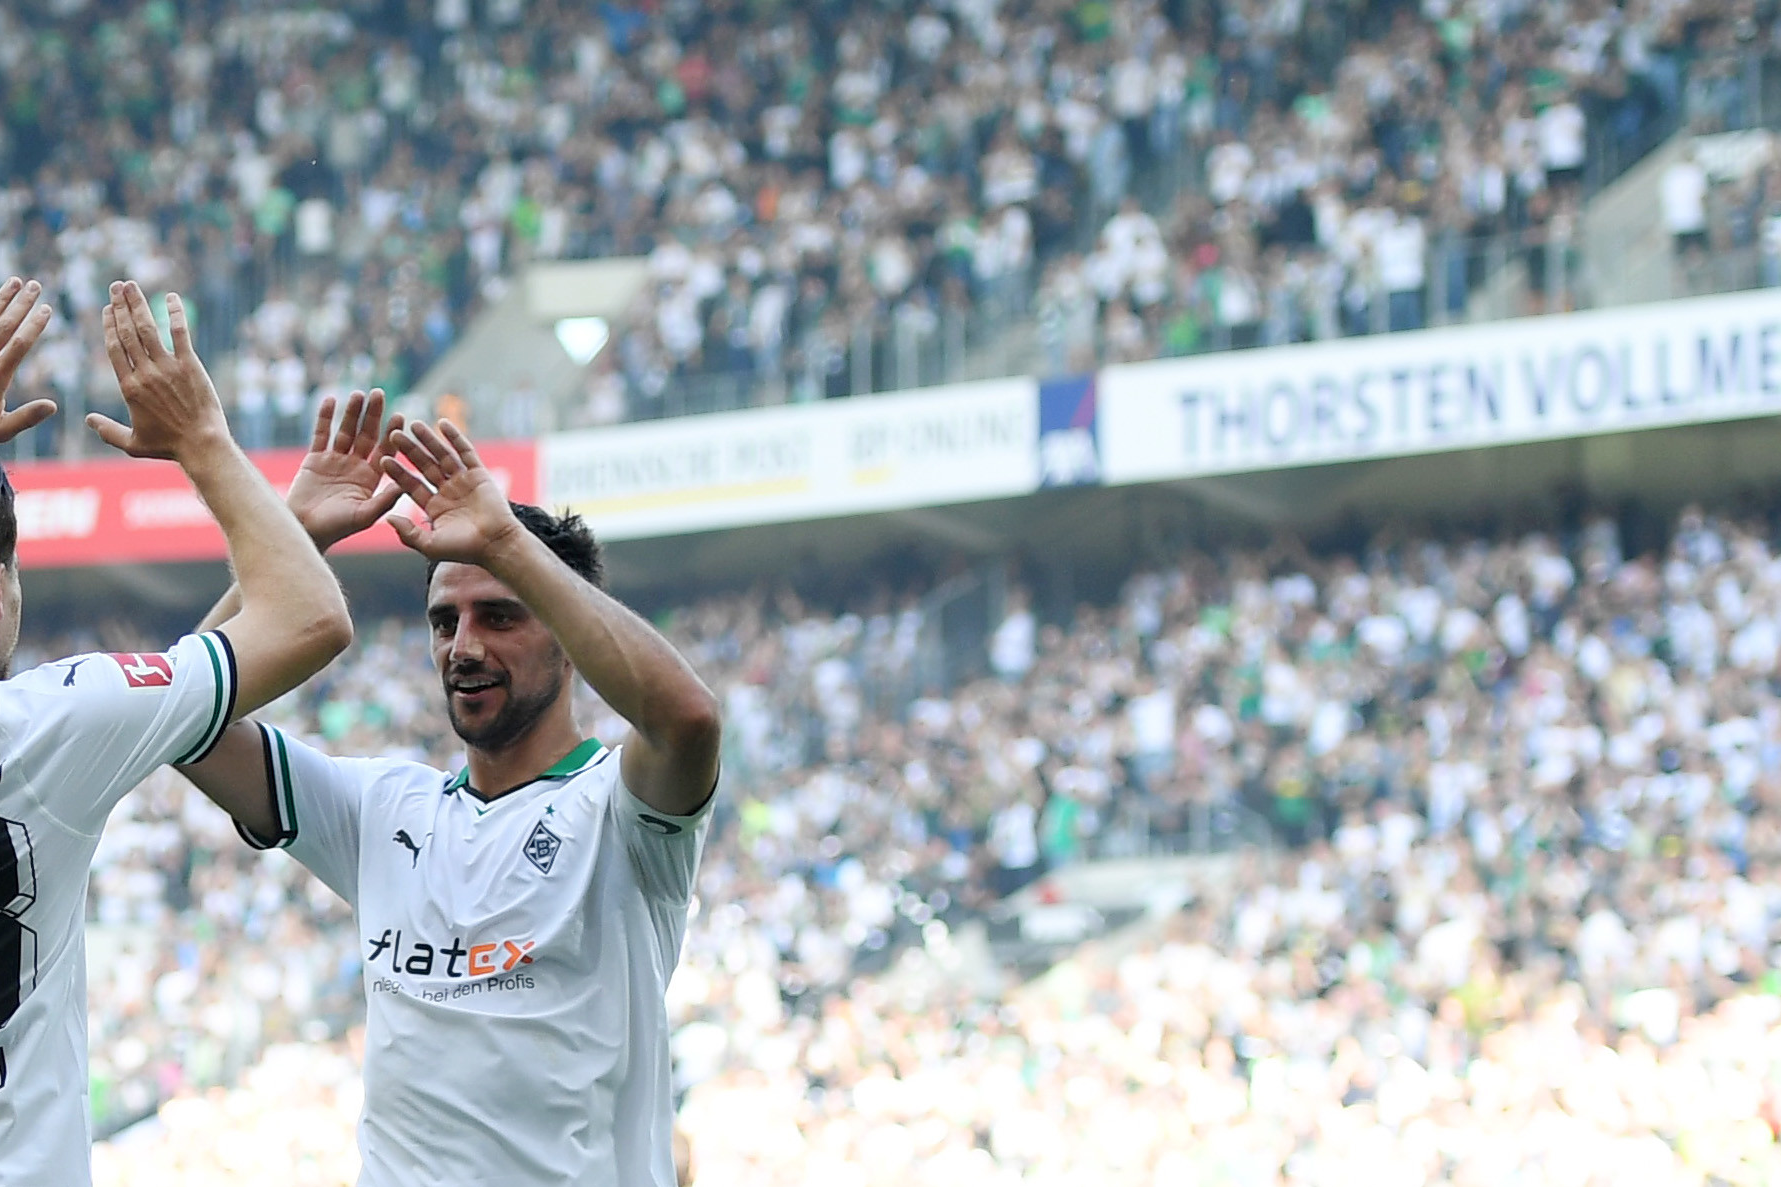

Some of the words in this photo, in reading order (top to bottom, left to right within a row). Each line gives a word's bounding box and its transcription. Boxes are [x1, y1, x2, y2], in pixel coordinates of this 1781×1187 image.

[1180, 360, 1500, 457] THORSTEN
[453, 982, 482, 999] den
[488, 973, 535, 992] Profis
